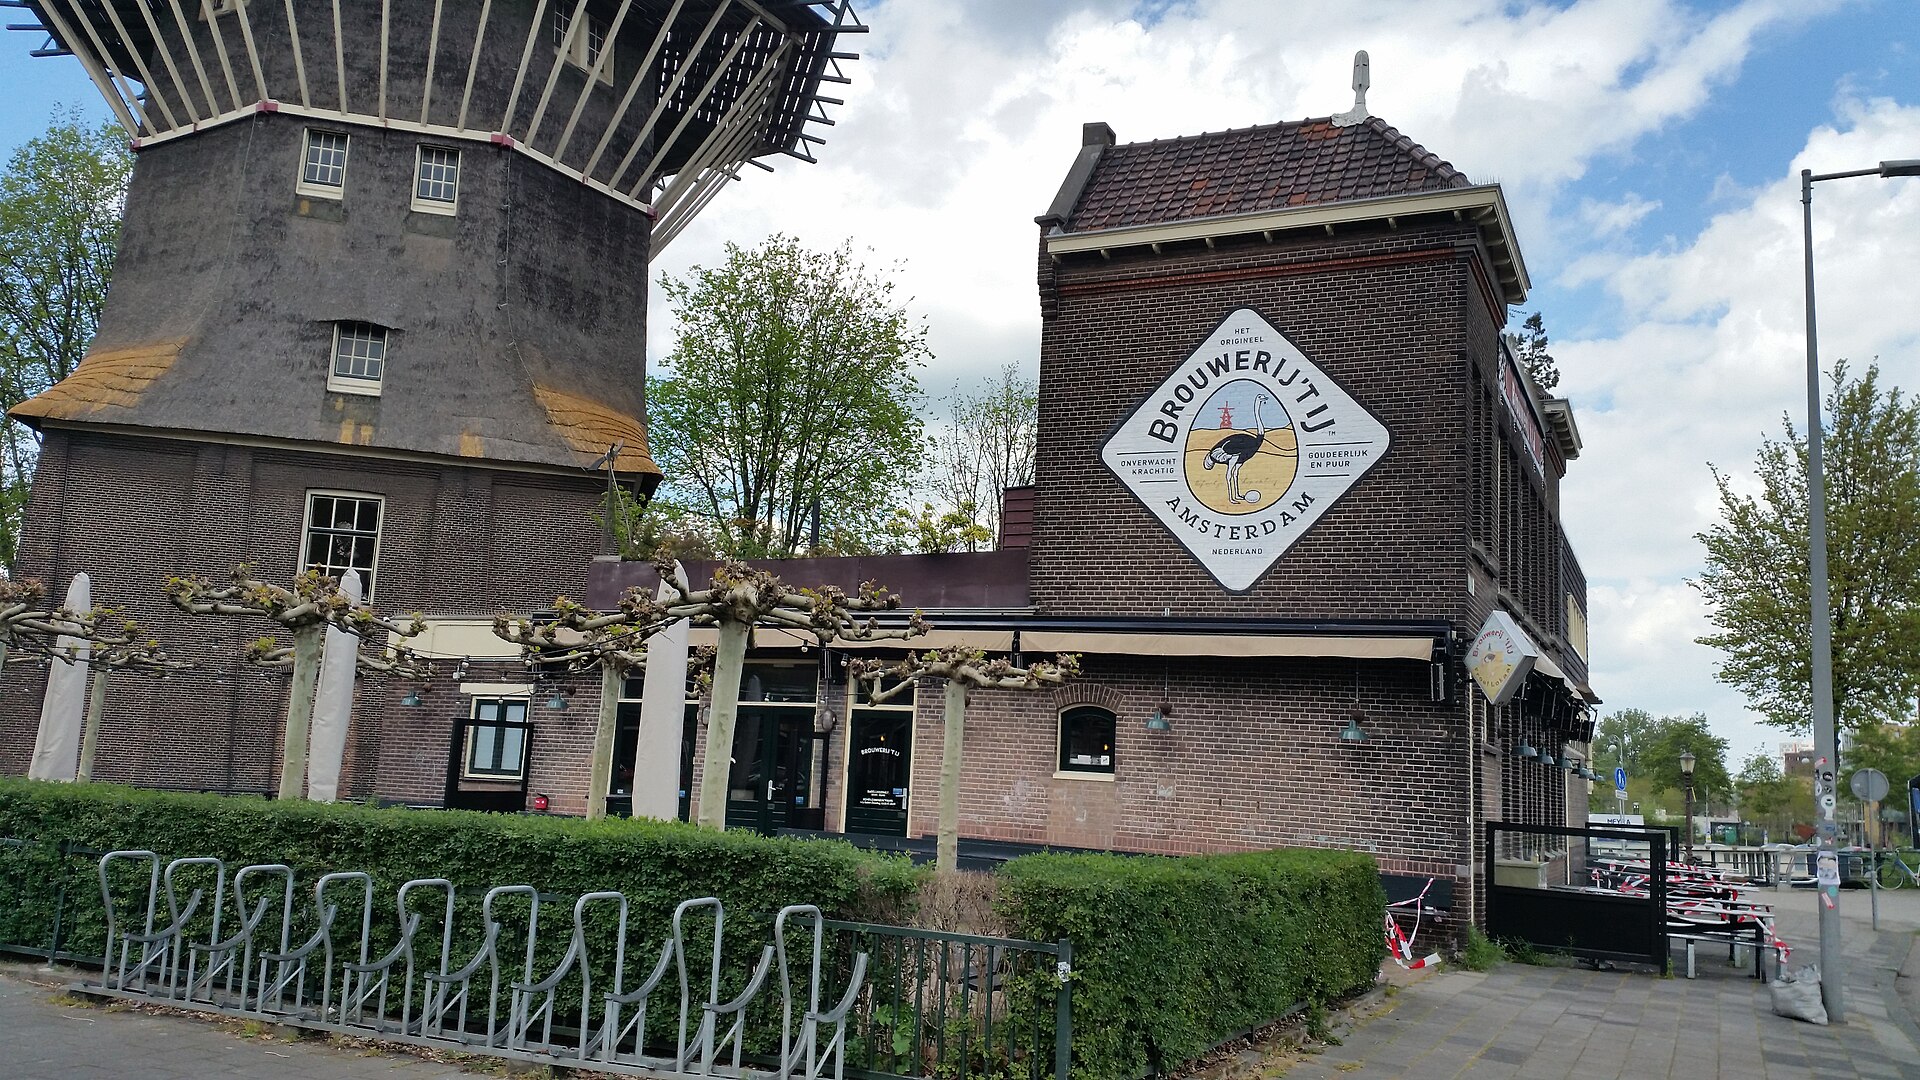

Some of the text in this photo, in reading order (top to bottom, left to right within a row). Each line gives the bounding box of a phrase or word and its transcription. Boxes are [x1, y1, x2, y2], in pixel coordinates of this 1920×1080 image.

[1234, 327, 1250, 335] HET
[1220, 336, 1264, 346] ORIGINEEL
[1308, 449, 1368, 459] GOUDEERLIJK
[1120, 458, 1177, 467] ONVERWACHT
[1310, 460, 1351, 469] EN PUUR
[1131, 467, 1175, 475] KRACHTIG
[1166, 491, 1316, 541] AMSTERDAM
[1211, 547, 1264, 556] NEDERLAND
